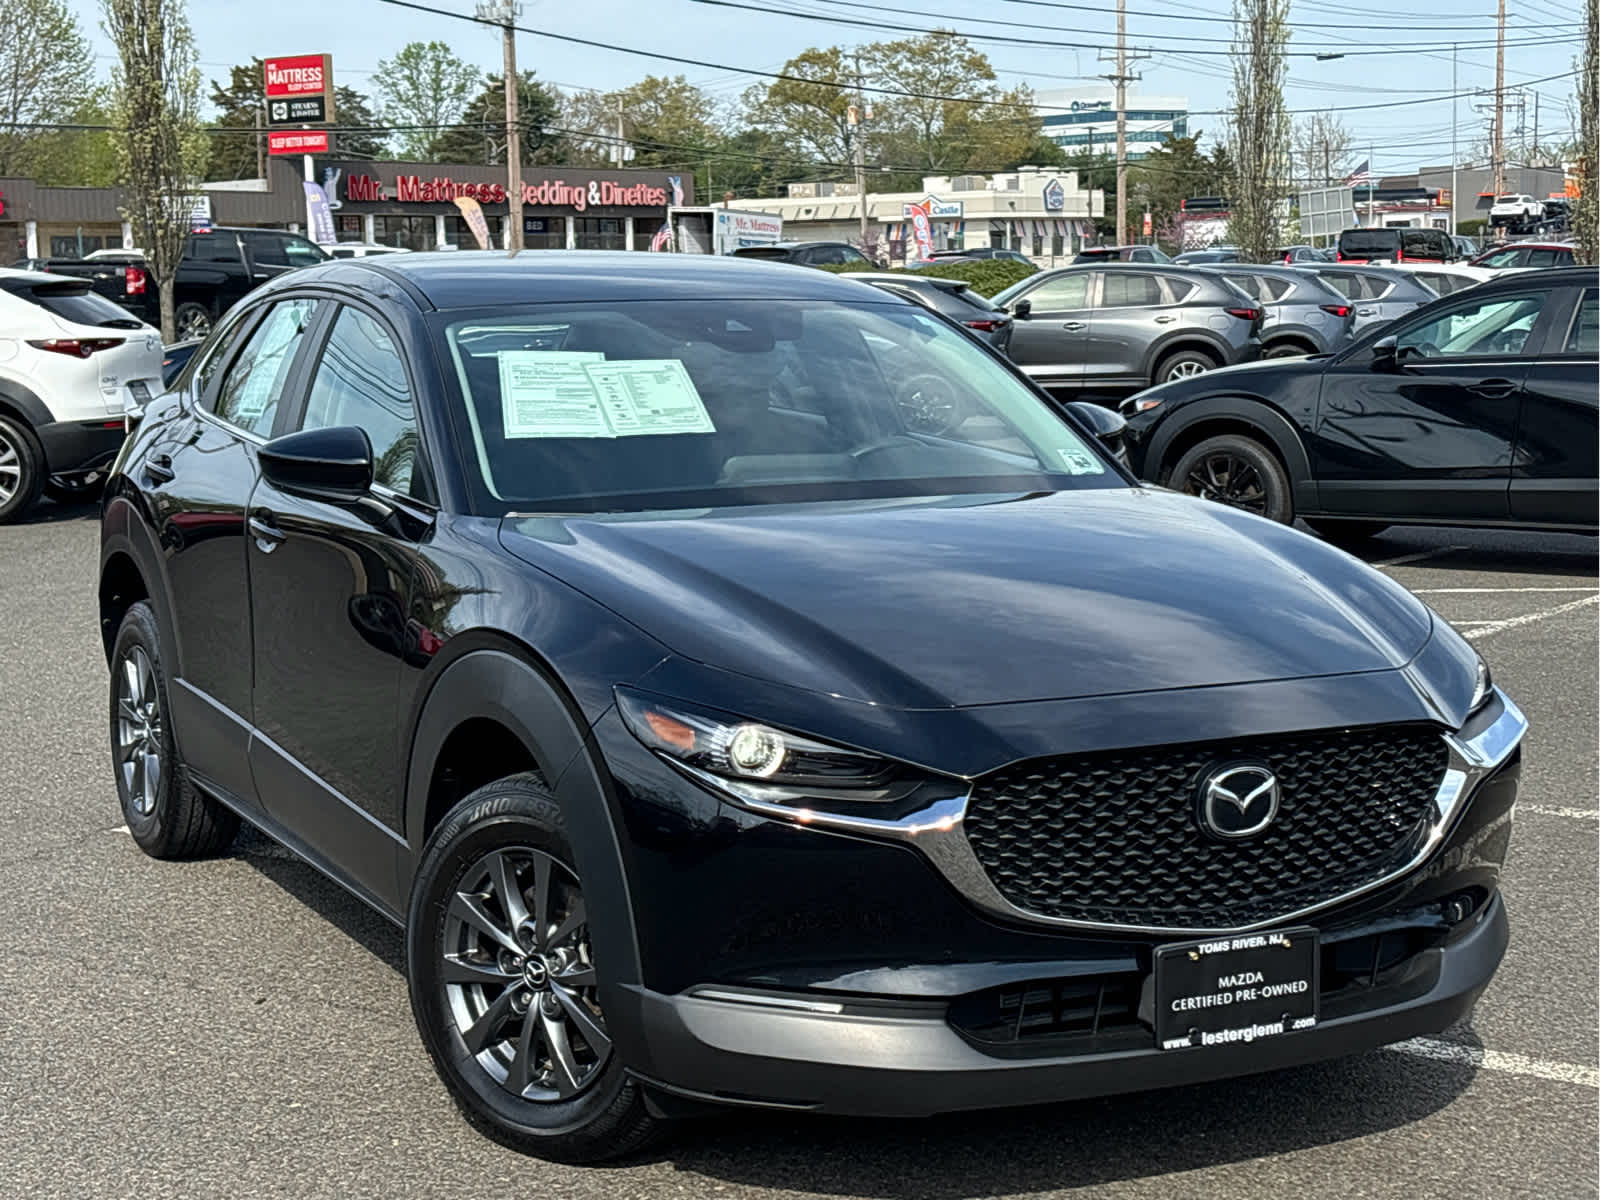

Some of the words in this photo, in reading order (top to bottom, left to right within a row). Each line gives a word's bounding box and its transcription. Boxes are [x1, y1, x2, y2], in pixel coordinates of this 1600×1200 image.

[268, 68, 322, 85] MATTRESS
[348, 175, 388, 201] Mr.
[397, 175, 506, 203] Mattress
[526, 221, 543, 231] BED
[1198, 941, 1230, 954] TOMS
[1269, 933, 1284, 945] NJ
[1218, 971, 1264, 988] MAZDA
[1171, 992, 1233, 1012] CERTIFIED
[1235, 980, 1308, 1002] PRE-OWNED
[1201, 1021, 1284, 1046] lesterglenn
